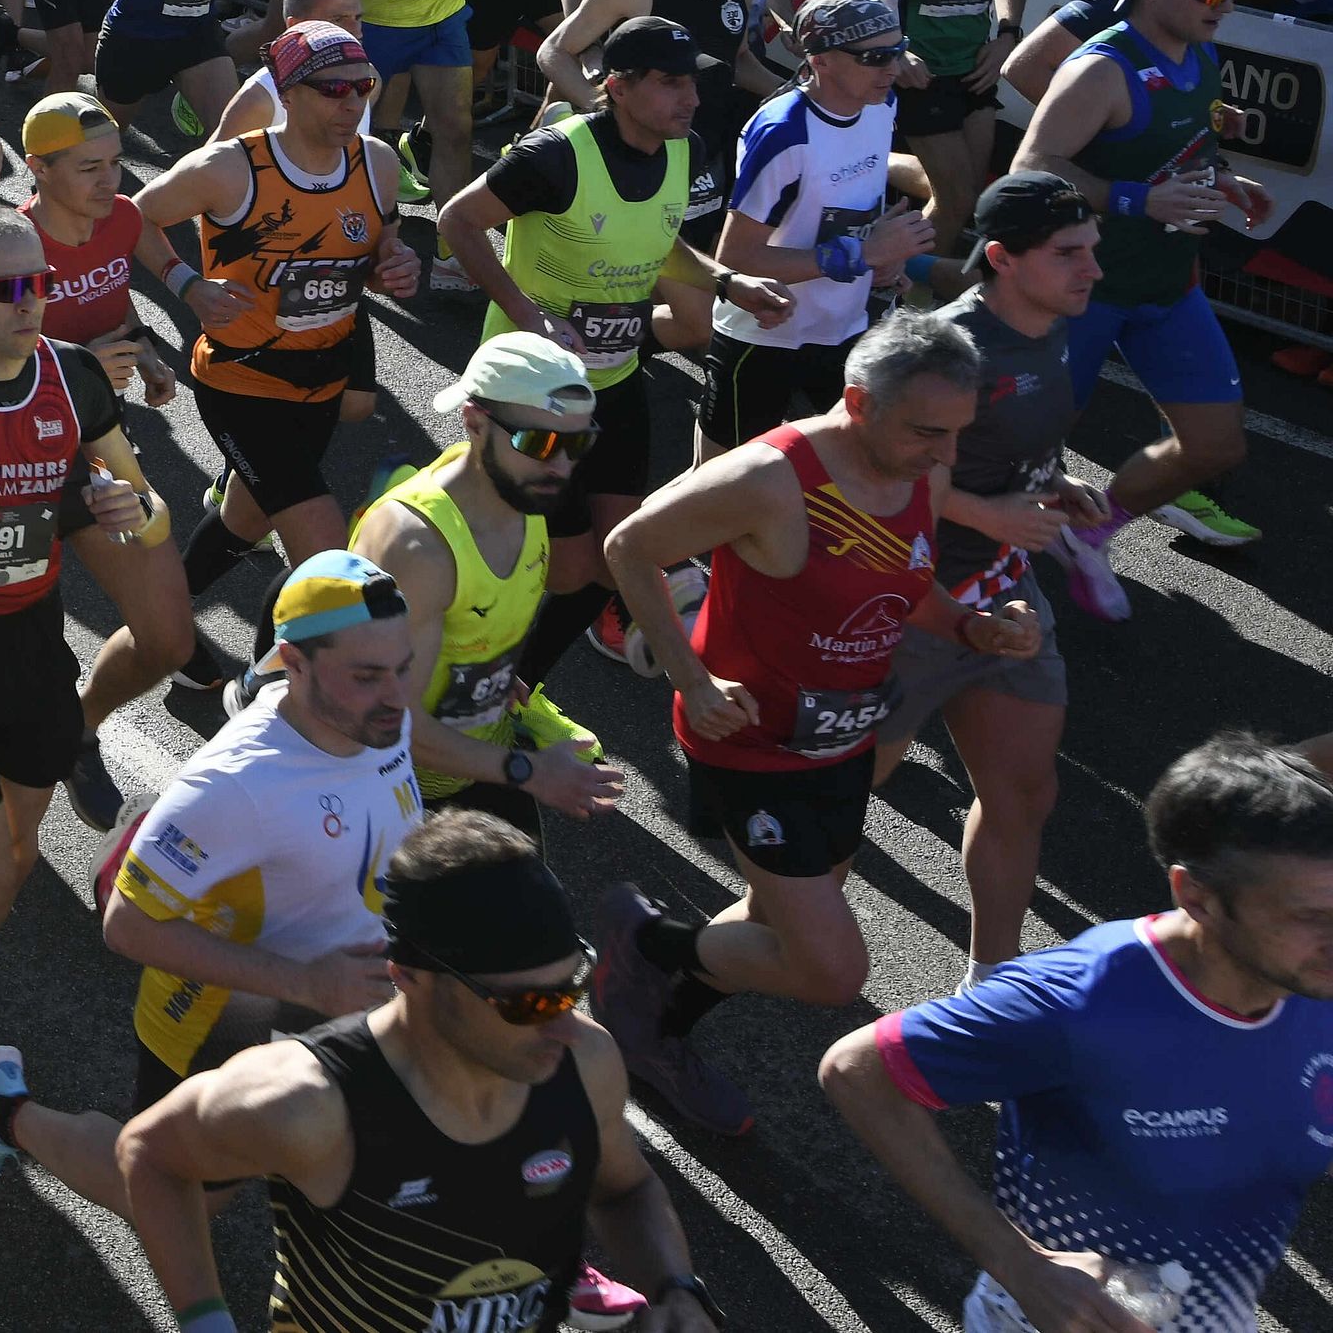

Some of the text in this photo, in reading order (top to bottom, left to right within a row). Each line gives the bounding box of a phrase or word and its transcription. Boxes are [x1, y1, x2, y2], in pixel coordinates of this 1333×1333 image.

[286, 271, 296, 281] A
[303, 279, 349, 300] 689
[572, 307, 583, 318] A
[584, 315, 643, 339] 5770
[810, 631, 879, 654] Martin
